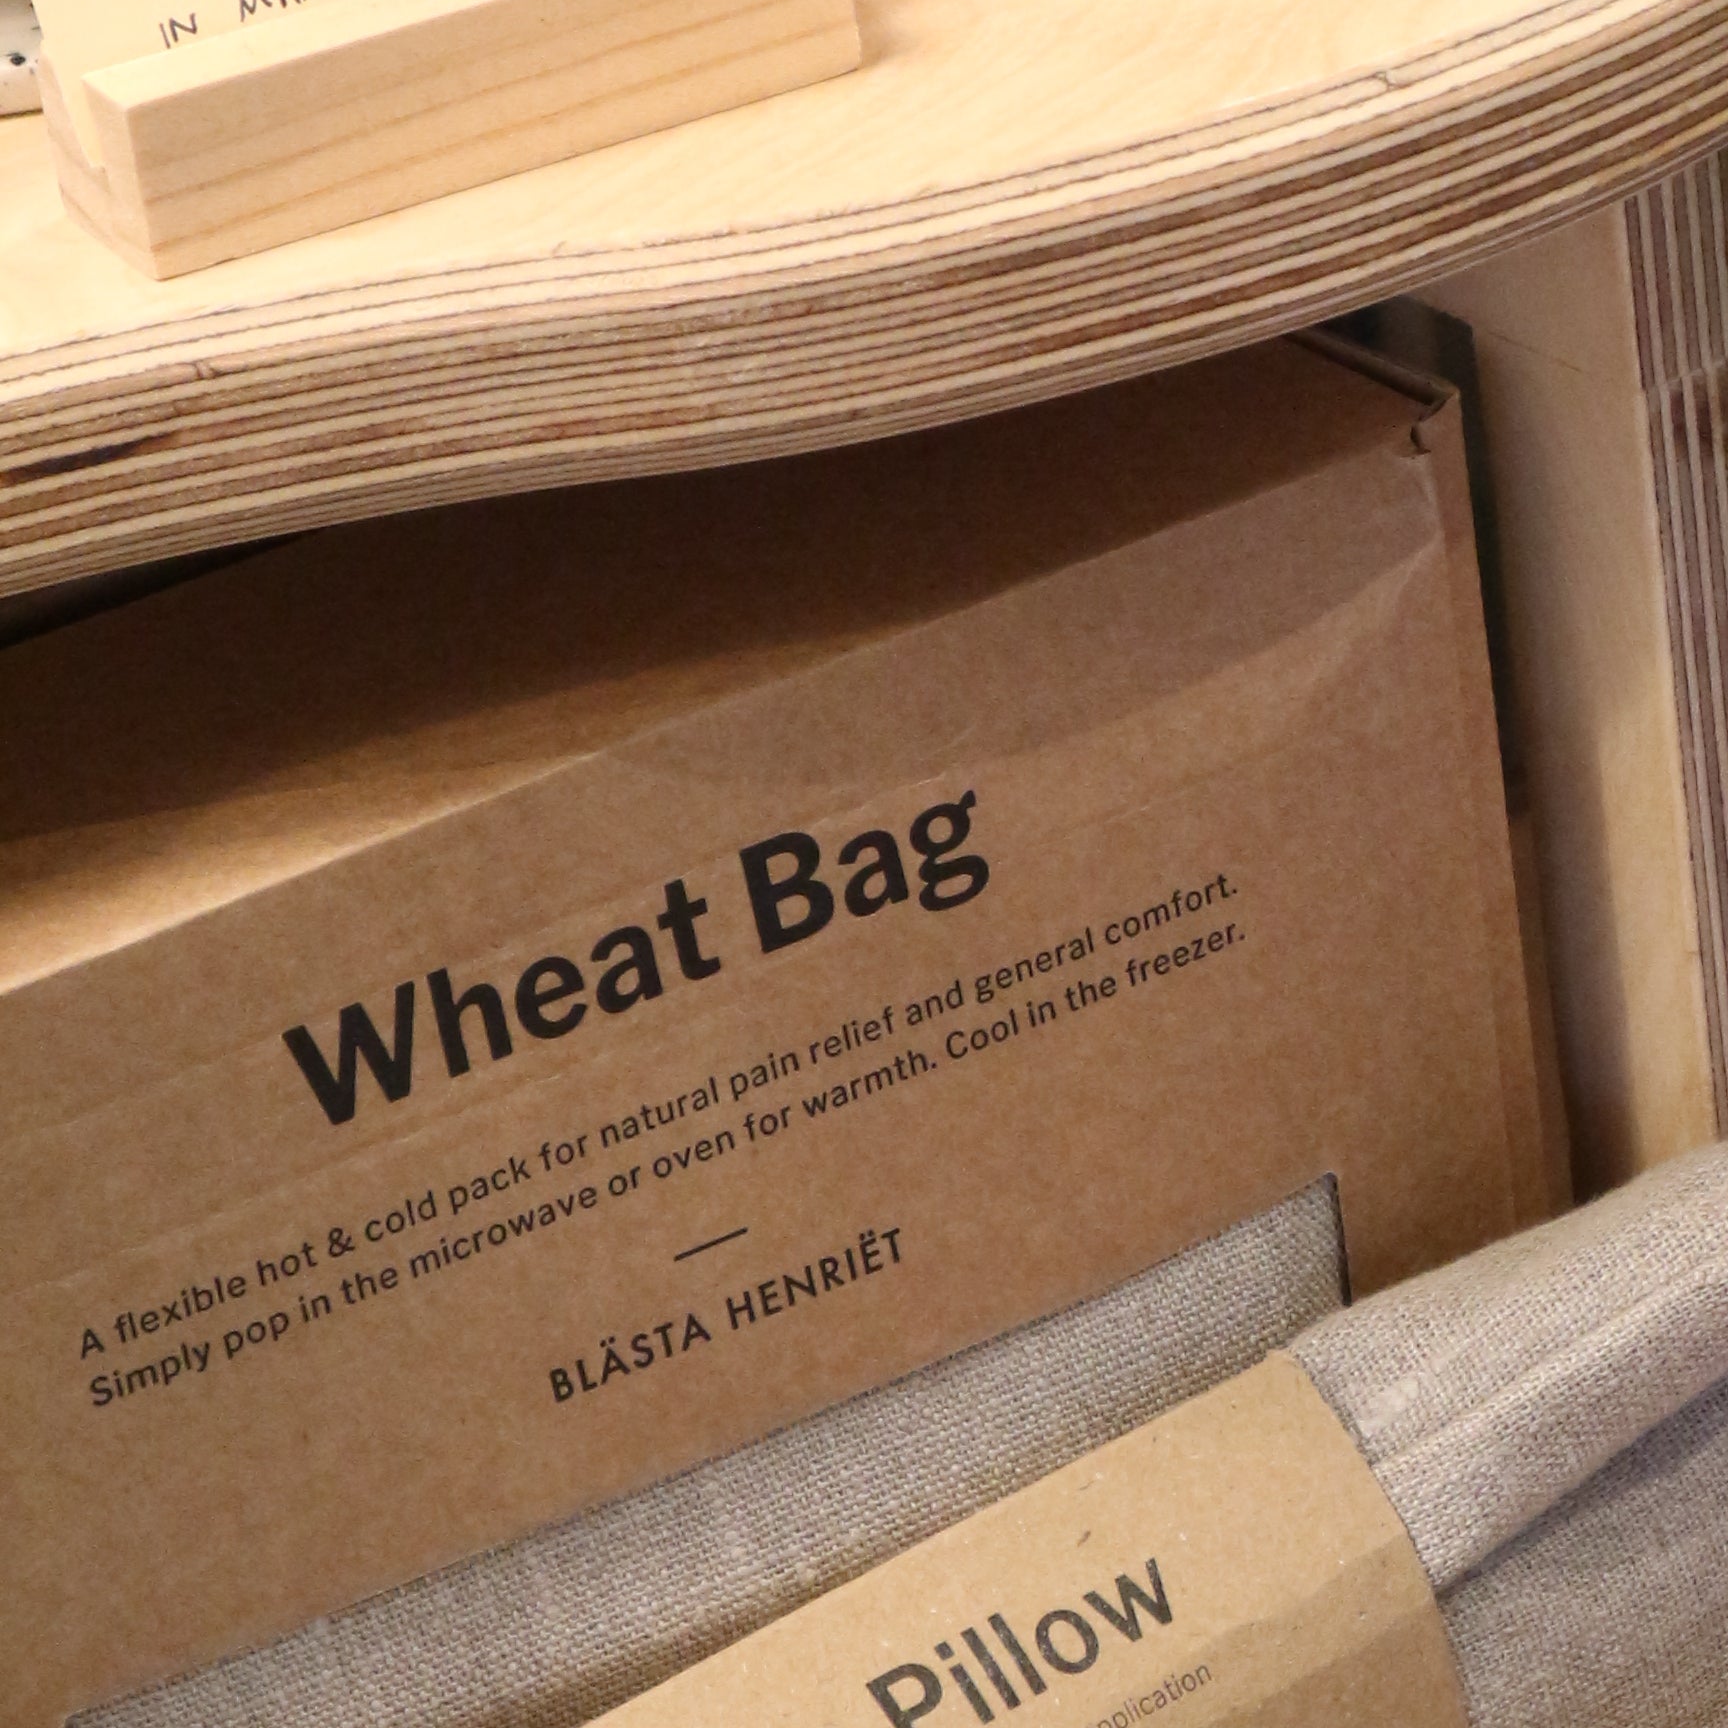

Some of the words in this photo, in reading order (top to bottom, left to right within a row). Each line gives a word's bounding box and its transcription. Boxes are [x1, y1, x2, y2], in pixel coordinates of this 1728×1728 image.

[158, 16, 200, 52] IN
[78, 1328, 106, 1360] A
[113, 1269, 248, 1346] flexible
[256, 1240, 319, 1288] hot
[326, 1226, 356, 1258] &
[364, 1190, 438, 1245] cold
[447, 1156, 532, 1216] pack
[537, 1132, 590, 1172] for
[599, 1075, 722, 1151] natural
[728, 1050, 801, 1103] pain
[809, 1005, 896, 1066] relief
[905, 981, 966, 1028] and
[974, 927, 1096, 1005] general
[1104, 873, 1238, 947] comfort.
[280, 877, 722, 1128] Wheat
[737, 789, 991, 957] Bag
[88, 1340, 212, 1408] Simply
[222, 1308, 292, 1362] pop
[298, 1292, 333, 1324] in
[340, 1264, 400, 1306] the
[408, 1186, 599, 1280] microwave
[607, 1165, 642, 1198] or
[651, 1128, 737, 1183] oven
[742, 1104, 791, 1143] for
[802, 1048, 938, 1120] warmth.
[945, 1013, 1020, 1062] Cool
[1028, 1001, 1058, 1029] in
[1065, 974, 1119, 1013] the
[1124, 919, 1246, 989] freezer.
[549, 1312, 712, 1404] BLÄSTA
[726, 1227, 902, 1331] HENRIËT
